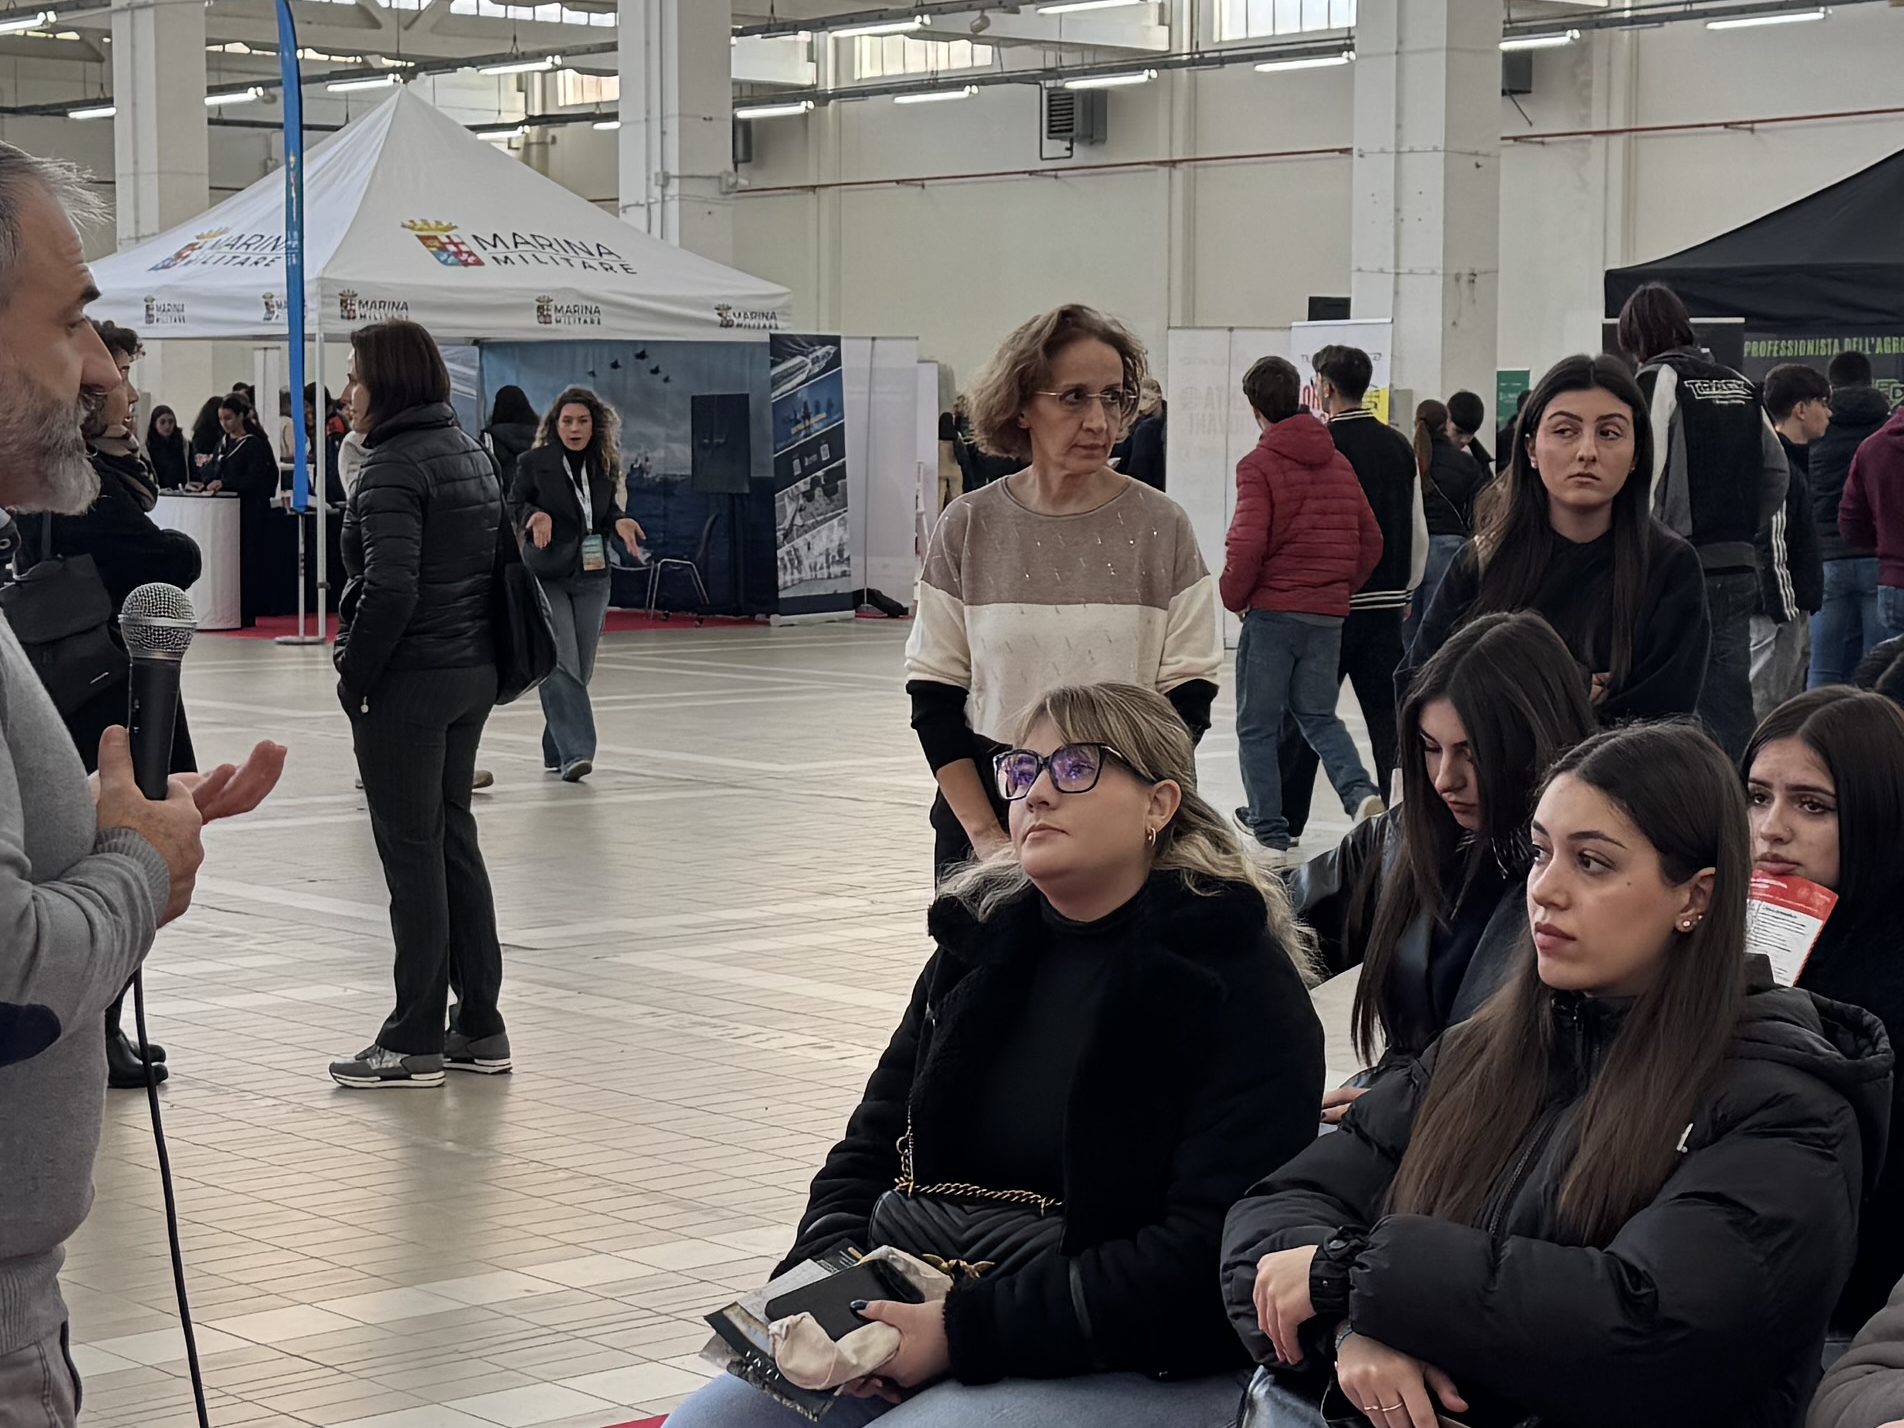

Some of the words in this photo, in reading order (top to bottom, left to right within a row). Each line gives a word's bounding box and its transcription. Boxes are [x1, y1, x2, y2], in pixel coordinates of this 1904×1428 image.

[207, 233, 288, 253] MARIN
[471, 232, 622, 259] MARINA
[488, 252, 638, 275] MILITARE
[155, 302, 185, 314] MARINA
[358, 299, 409, 312] MARINA
[554, 305, 602, 316] MARINA
[732, 311, 777, 321] MARINA
[1743, 338, 1840, 357] PROFESSIONISTA
